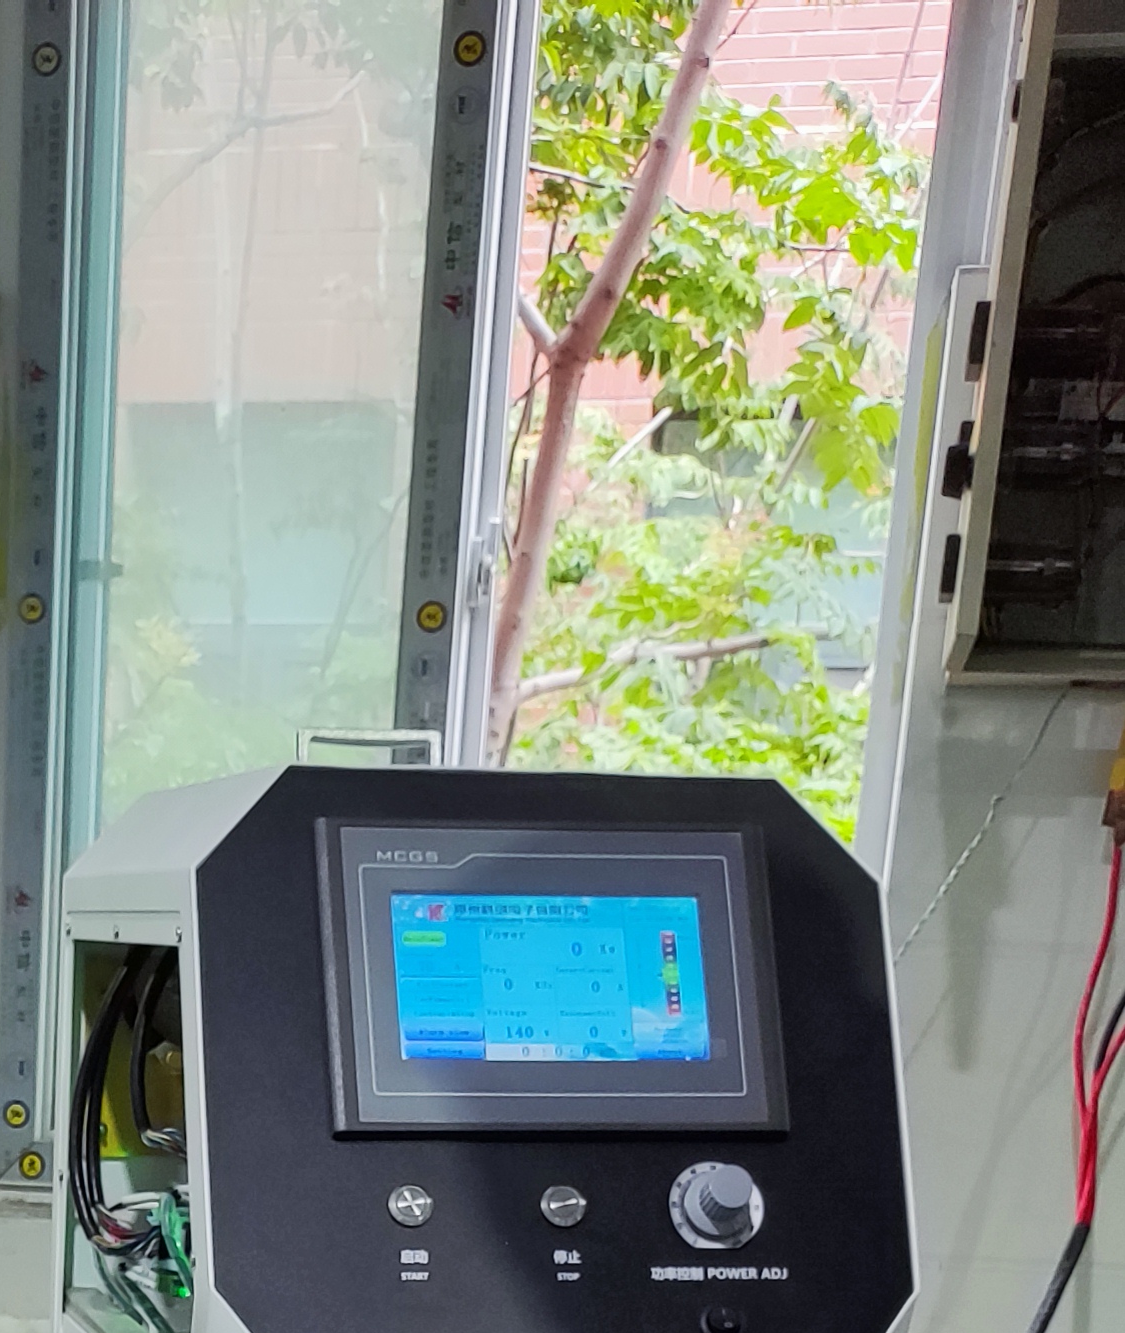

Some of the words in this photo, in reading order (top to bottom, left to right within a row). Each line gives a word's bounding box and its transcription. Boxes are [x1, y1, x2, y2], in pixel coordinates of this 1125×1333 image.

[571, 942, 583, 957] 0
[503, 977, 513, 991] 0
[591, 980, 601, 993] 0
[506, 1026, 534, 1039] 140
[589, 1026, 599, 1038] 0
[707, 1266, 758, 1280] POWER
[761, 1266, 789, 1280] ADJ
